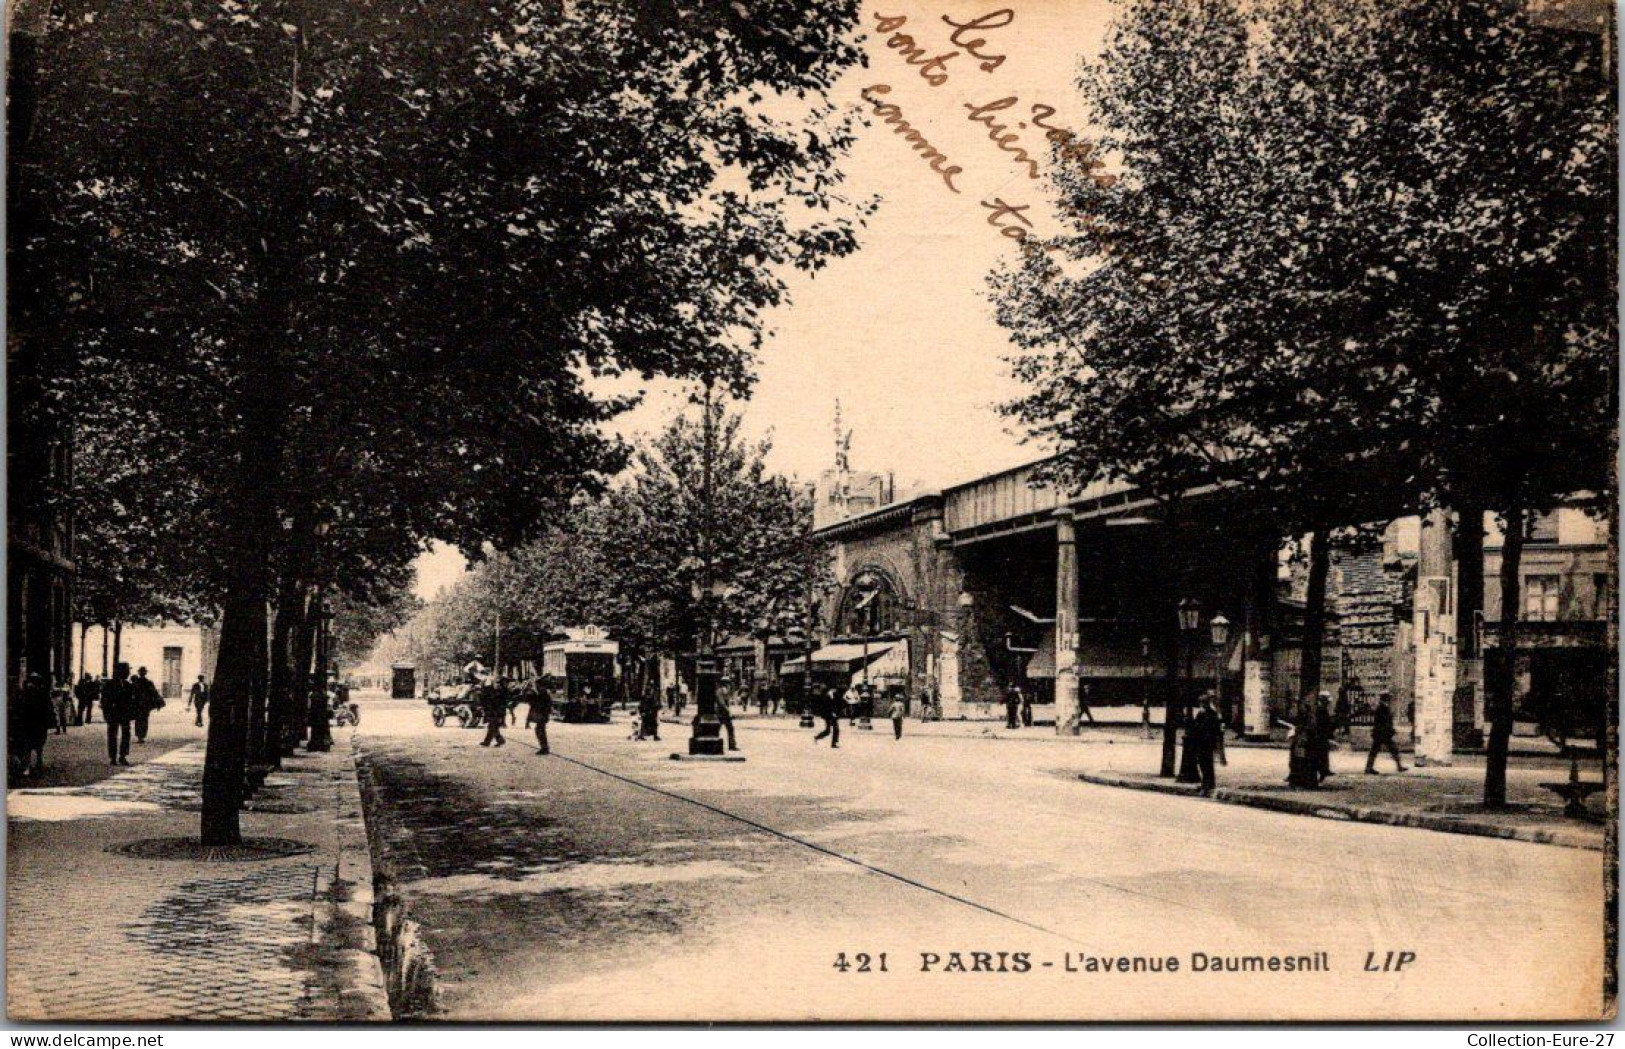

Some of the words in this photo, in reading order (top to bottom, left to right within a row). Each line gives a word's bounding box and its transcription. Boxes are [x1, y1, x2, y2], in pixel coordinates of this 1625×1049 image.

[941, 9, 1014, 73] les
[861, 85, 962, 193] comme
[964, 97, 1040, 179] bien
